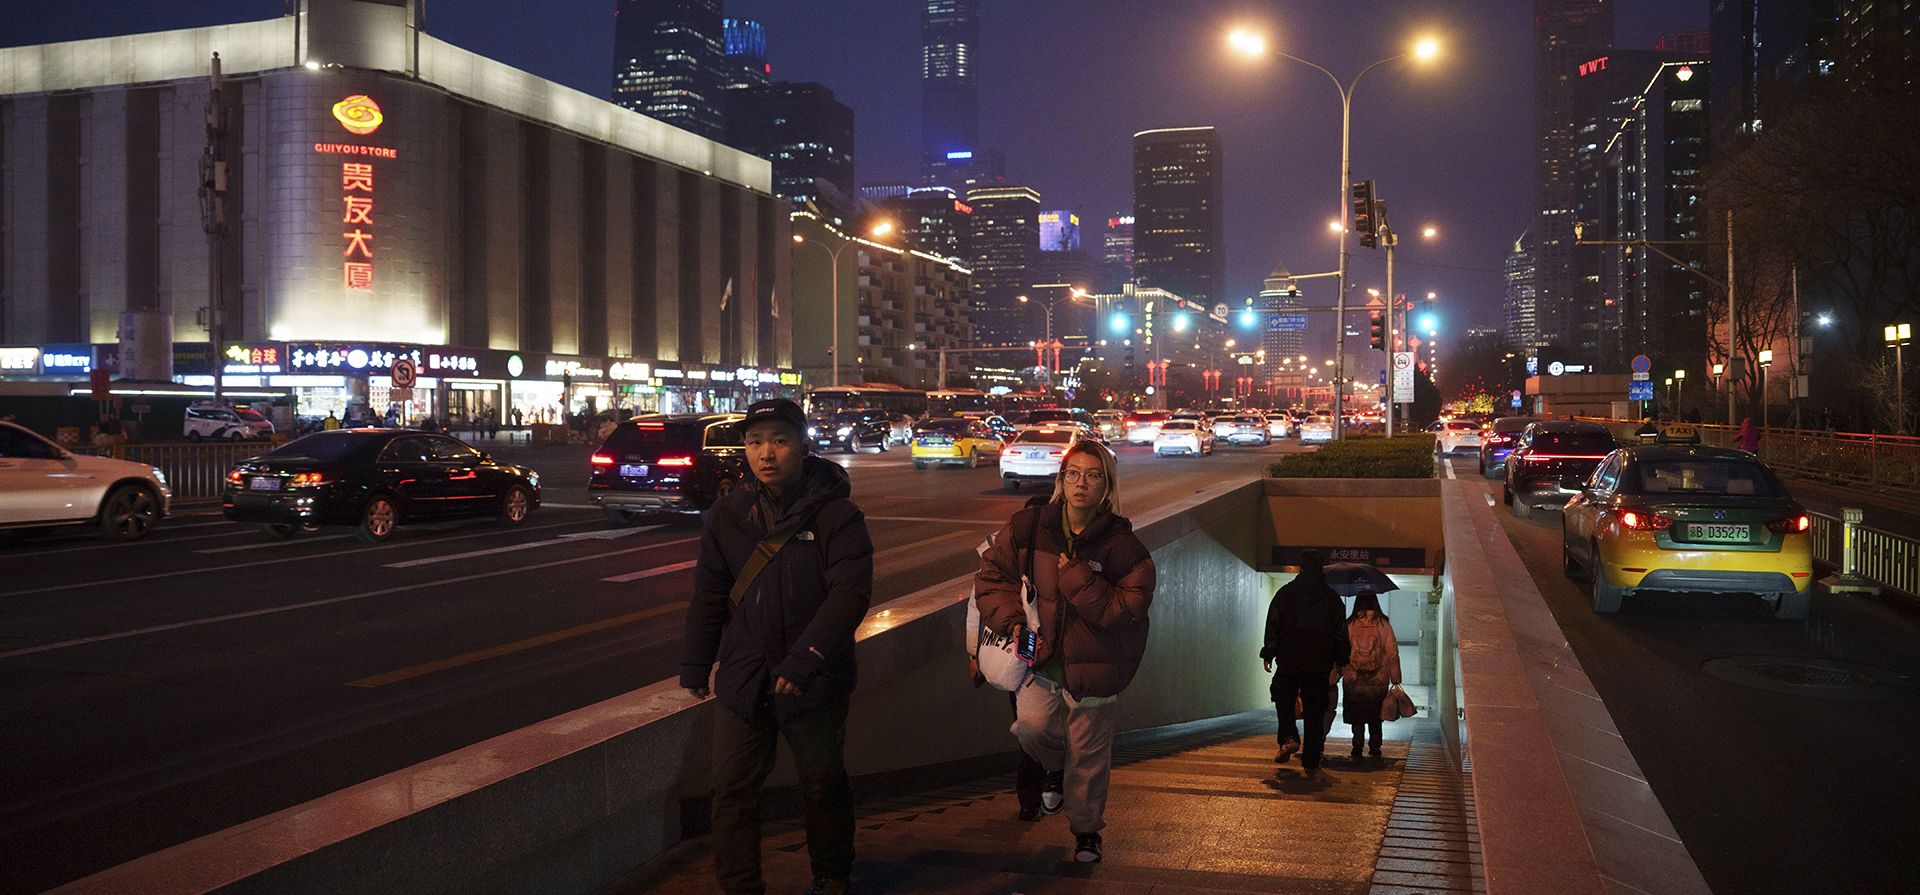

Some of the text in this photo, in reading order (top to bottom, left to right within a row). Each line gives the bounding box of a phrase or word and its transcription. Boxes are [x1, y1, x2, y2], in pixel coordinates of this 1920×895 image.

[1579, 56, 1609, 77] WWT
[314, 143, 397, 158] GUIYOU STORE
[342, 162, 374, 293] 贵友大厦
[1670, 427, 1692, 435] TAXI
[1708, 526, 1749, 539] D35275
[1329, 549, 1370, 561] 永安里站
